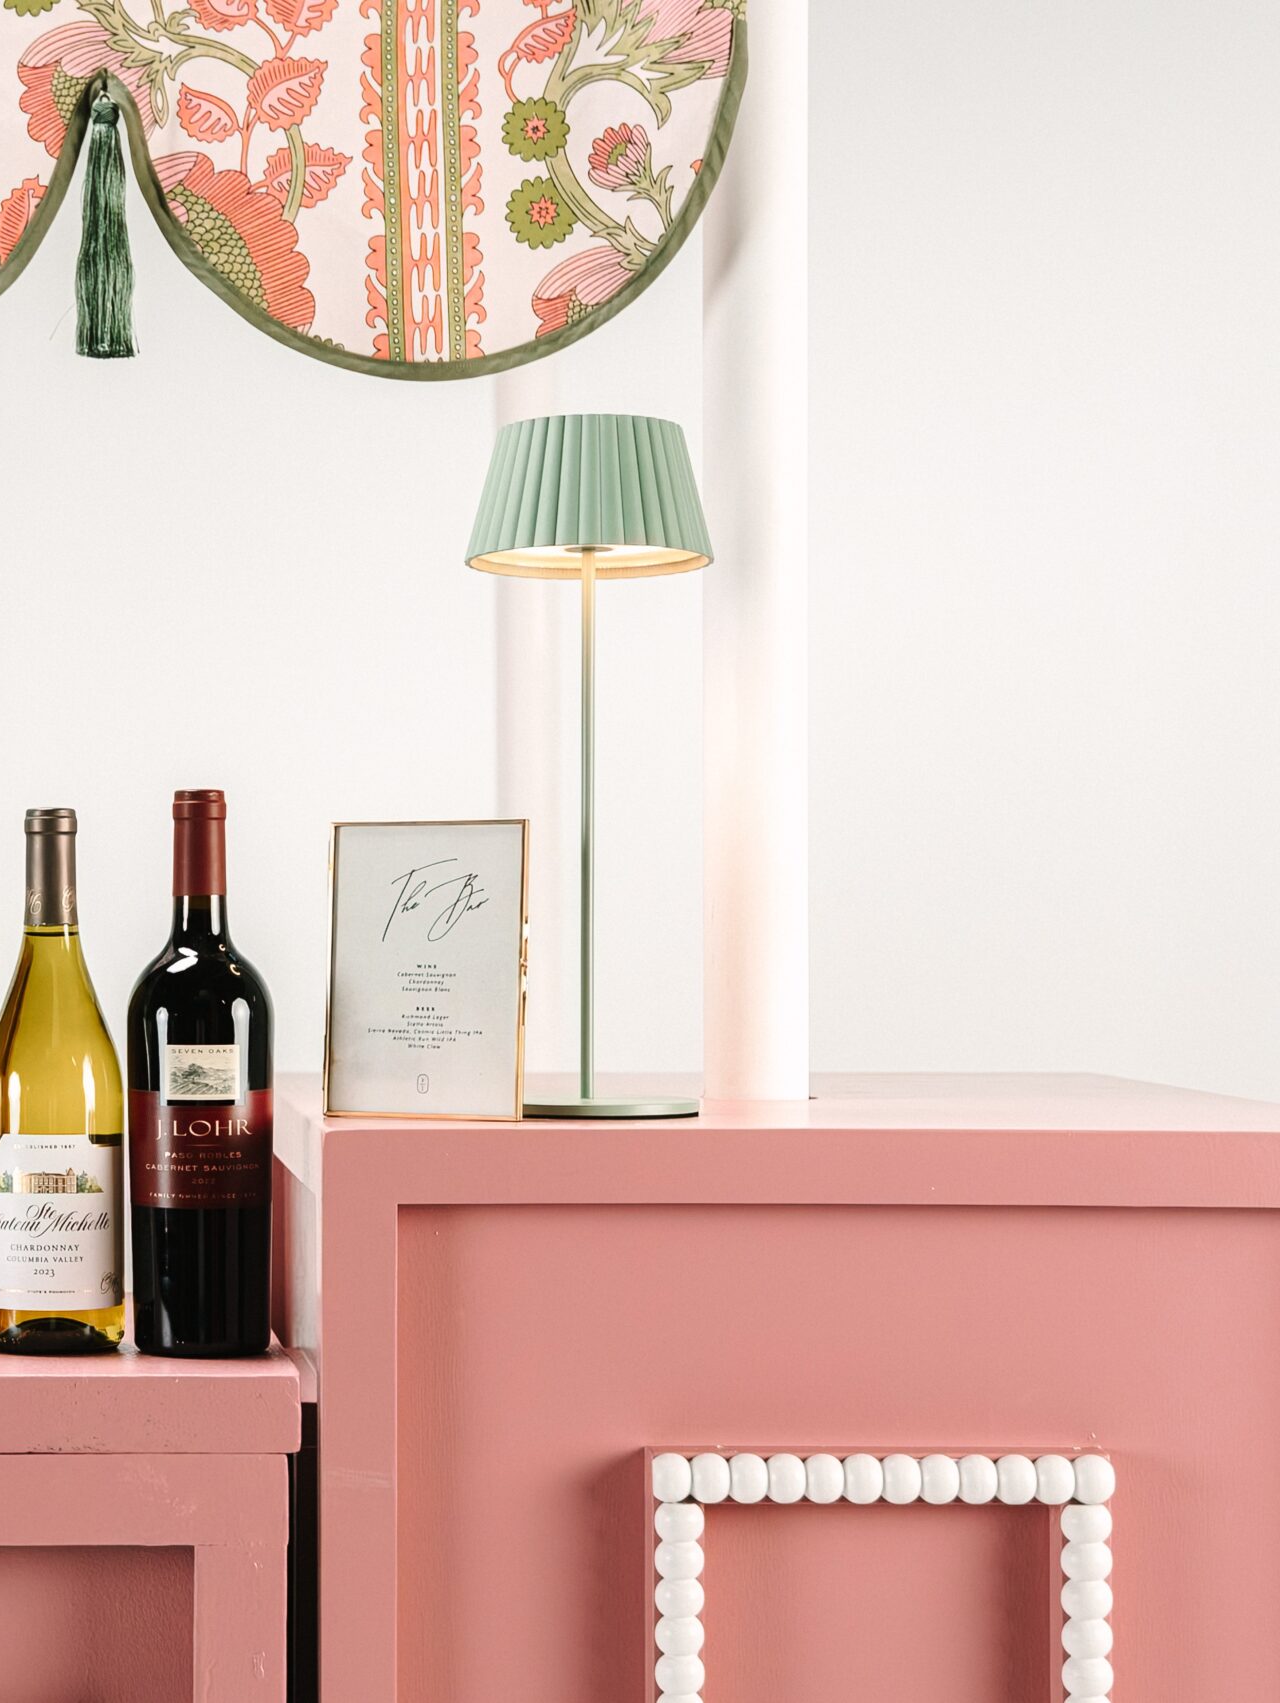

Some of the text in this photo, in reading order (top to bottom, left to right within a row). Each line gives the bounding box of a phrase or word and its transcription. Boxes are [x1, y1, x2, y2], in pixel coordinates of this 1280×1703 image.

[382, 858, 489, 942] The Bar
[156, 1119, 252, 1140] J. LOHR
[145, 1163, 260, 1172] CABERNET SAUVIGNON
[26, 1201, 56, 1221] Ste
[29, 1210, 110, 1238] Michelle
[10, 1244, 80, 1252] CHARDONNAY
[6, 1255, 84, 1263] COLUMBIA VALLEY
[33, 1268, 56, 1278] 2023
